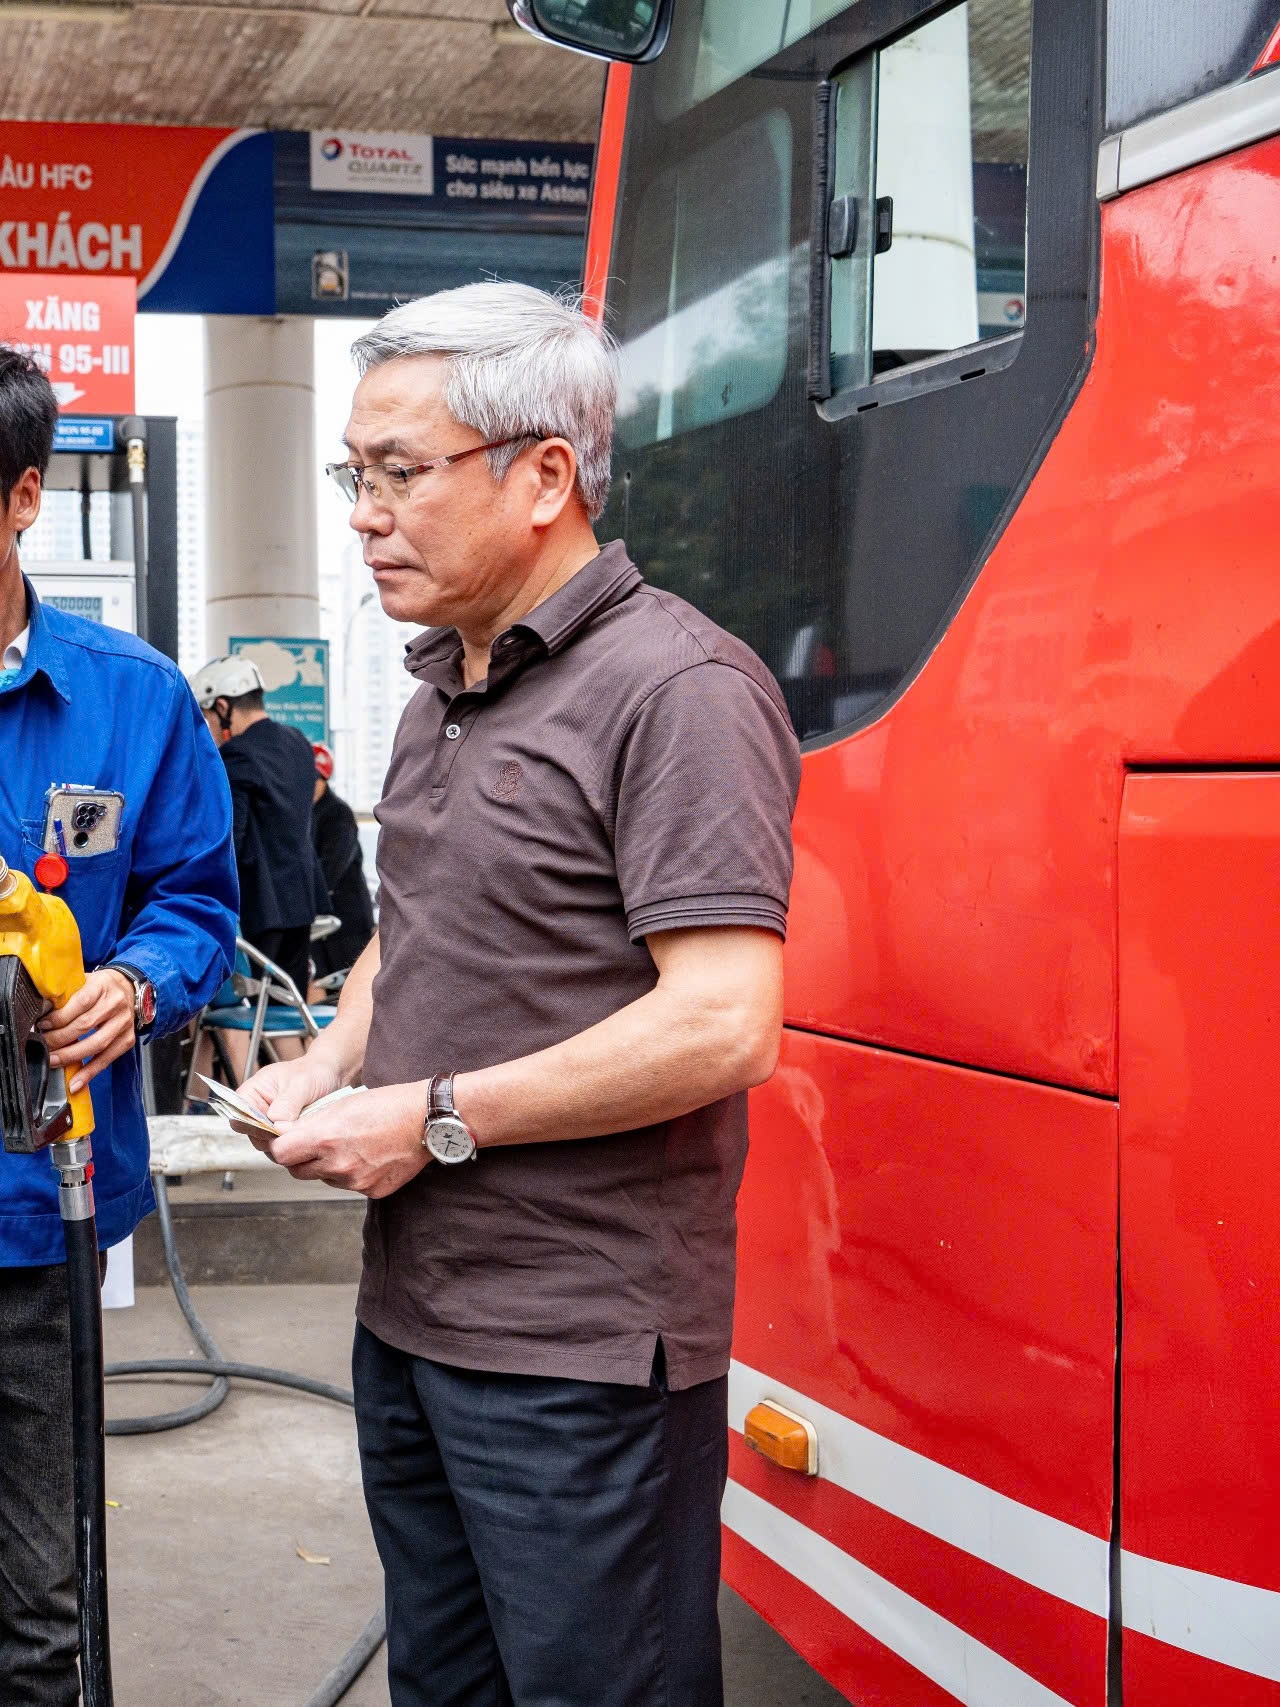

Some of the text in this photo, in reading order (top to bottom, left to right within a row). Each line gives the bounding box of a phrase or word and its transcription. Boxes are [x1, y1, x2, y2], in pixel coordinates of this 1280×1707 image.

[347, 143, 415, 162] TOTAL
[40, 163, 93, 190] HFC
[445, 179, 478, 198] cho
[25, 294, 101, 332] XĂNG
[59, 343, 130, 375] 95-III
